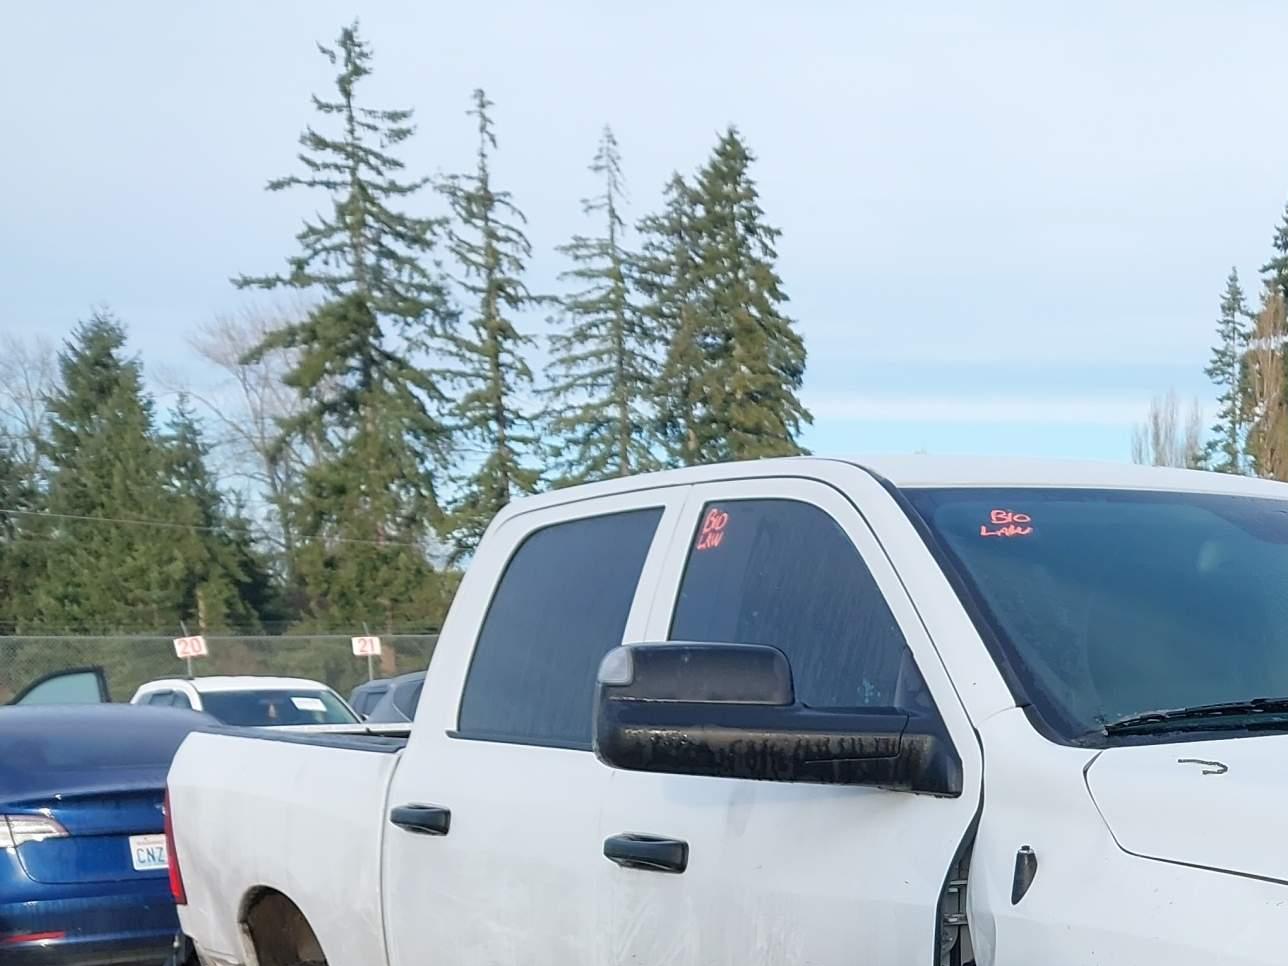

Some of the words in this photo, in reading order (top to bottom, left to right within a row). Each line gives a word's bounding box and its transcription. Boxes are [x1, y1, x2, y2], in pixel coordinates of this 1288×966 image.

[177, 638, 202, 655] 20
[357, 638, 375, 653] 21
[136, 846, 165, 864] CNZ
